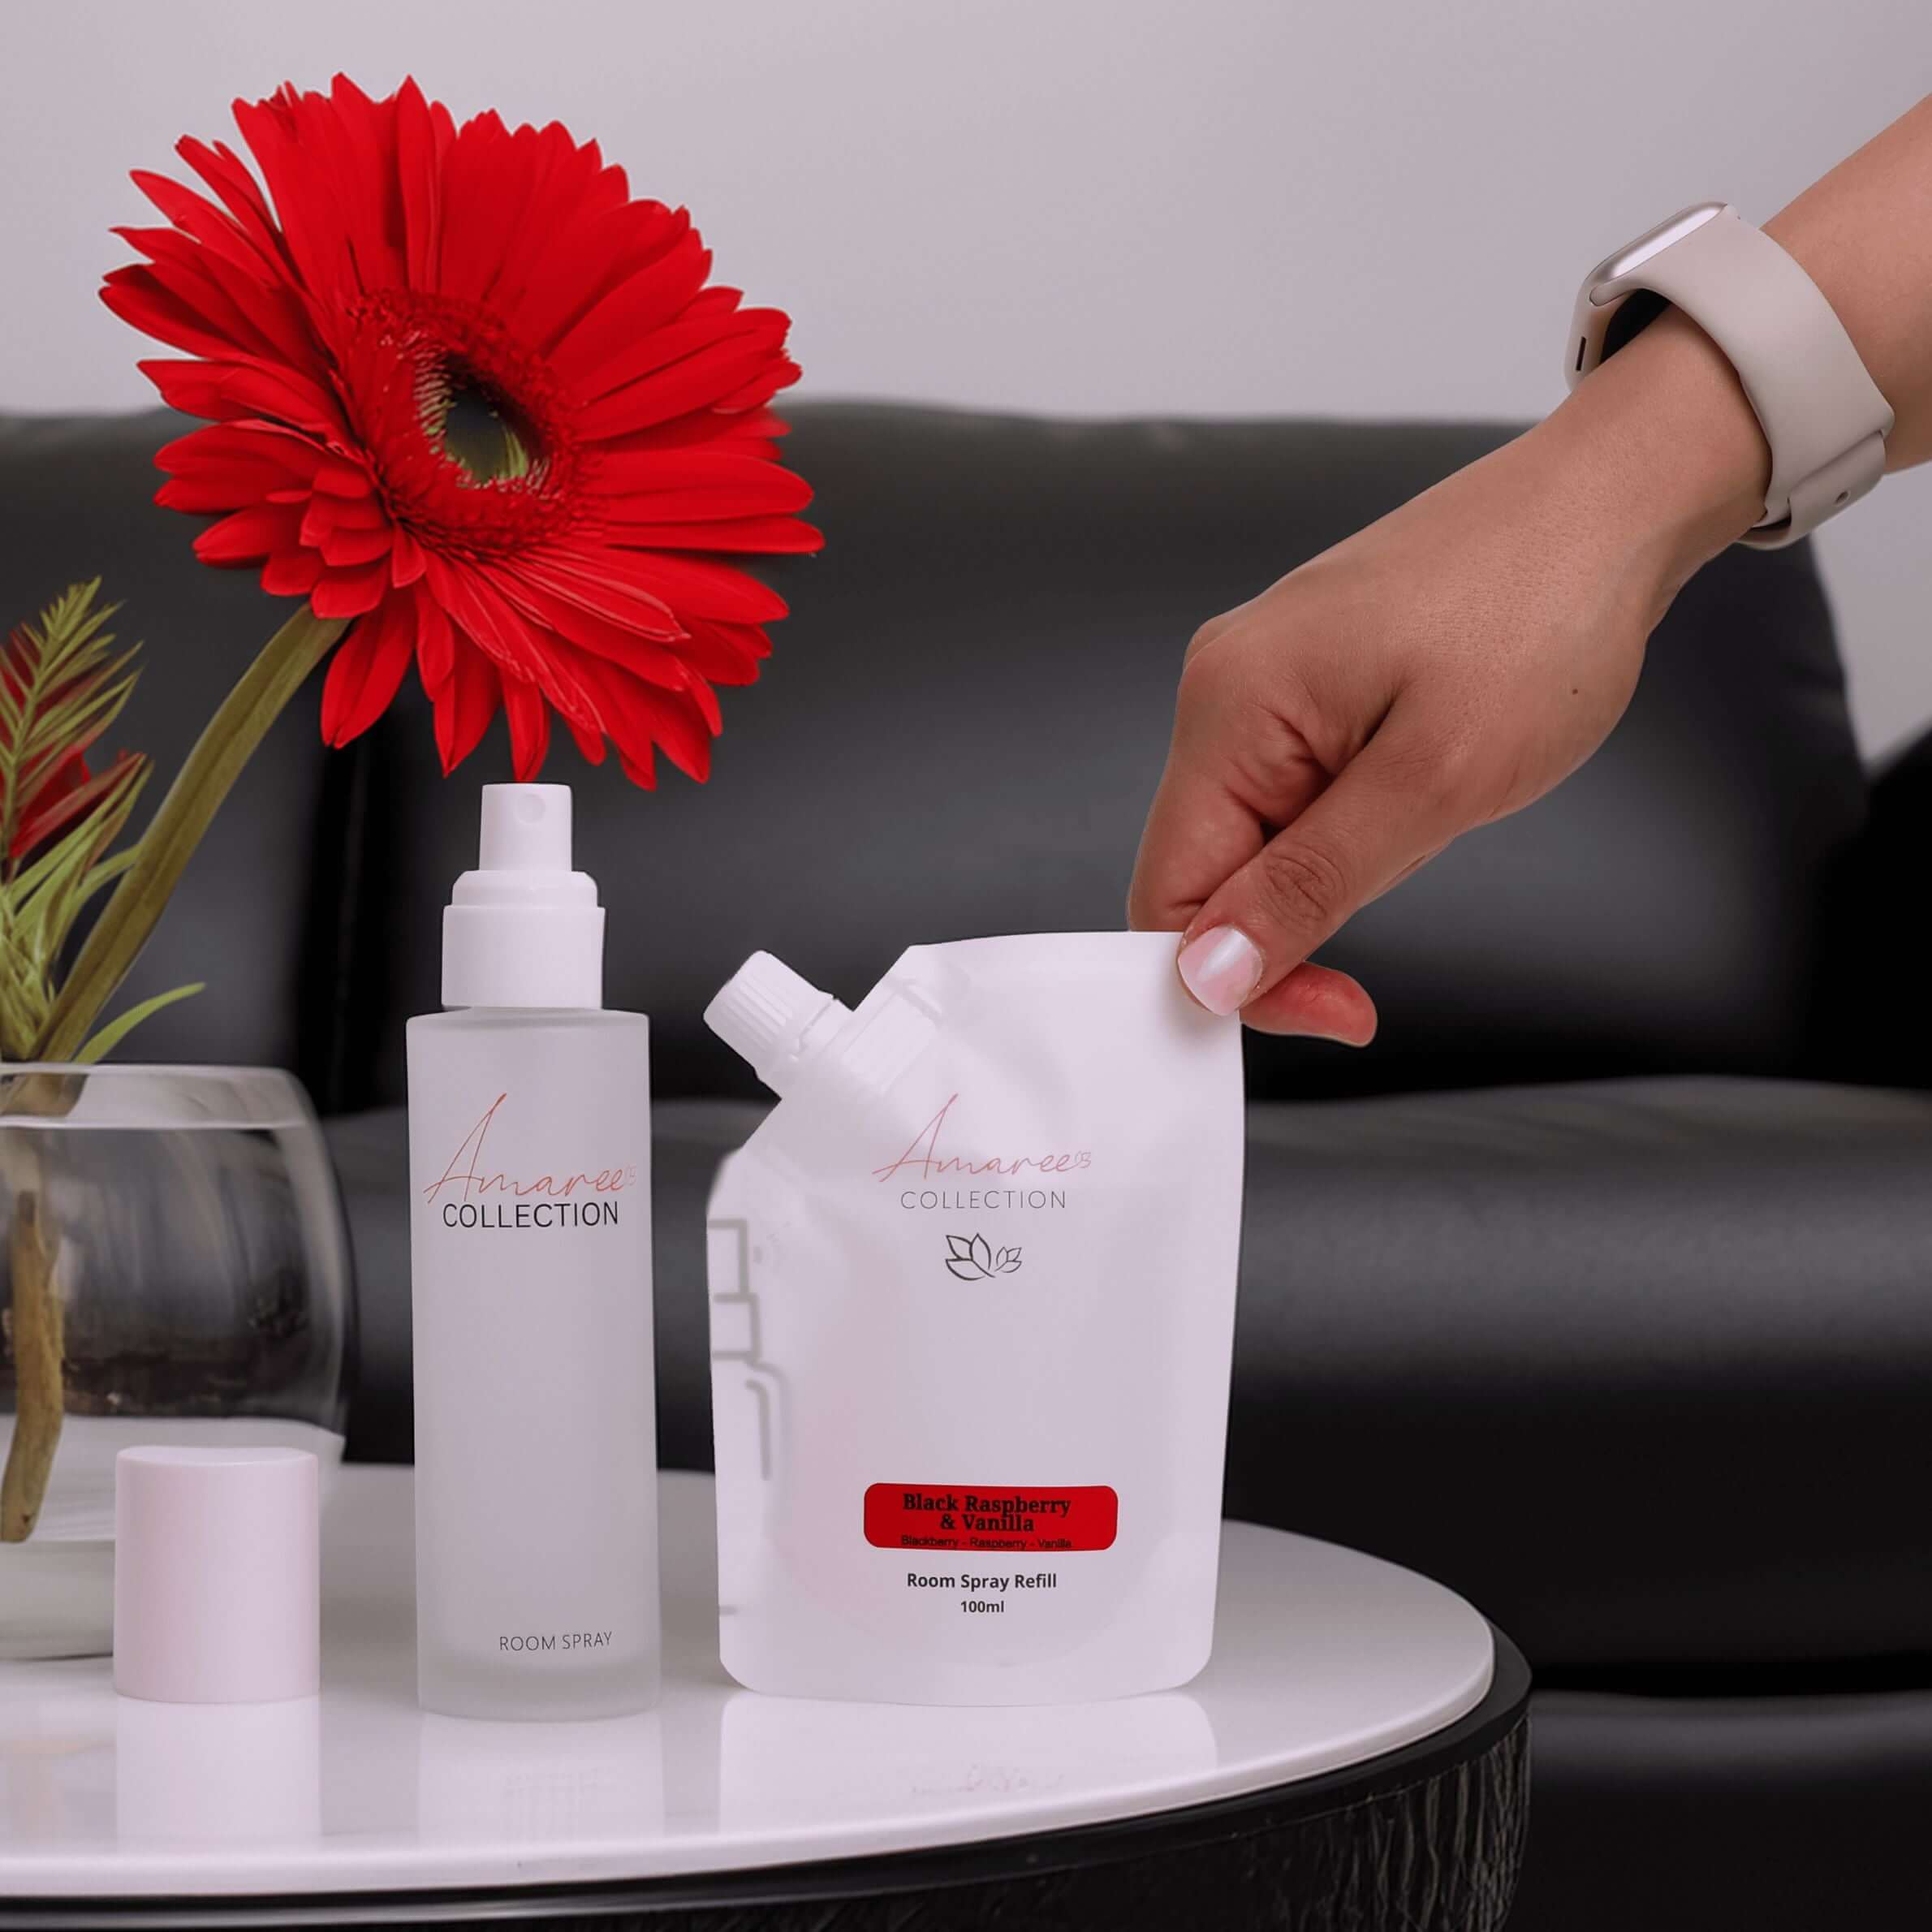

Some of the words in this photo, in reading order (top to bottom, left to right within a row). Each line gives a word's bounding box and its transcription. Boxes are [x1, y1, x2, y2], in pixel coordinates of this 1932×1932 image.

[900, 1190, 1066, 1210] COLLECTION
[442, 1201, 619, 1228] COLLECTION
[903, 1493, 959, 1512] Black
[964, 1495, 1072, 1517] Raspberry
[939, 1513, 956, 1530] &
[961, 1513, 1034, 1532] Vanilla
[901, 1534, 959, 1548] Blackberry
[969, 1537, 1027, 1550] Raspberry
[1038, 1537, 1072, 1547] Vanilla
[907, 1573, 955, 1589] Room
[960, 1574, 1009, 1593] Spray
[1014, 1573, 1057, 1589] Refill
[960, 1600, 1004, 1613] 100ml
[499, 1636, 556, 1651] ROOM
[562, 1631, 612, 1650] SPRAY
